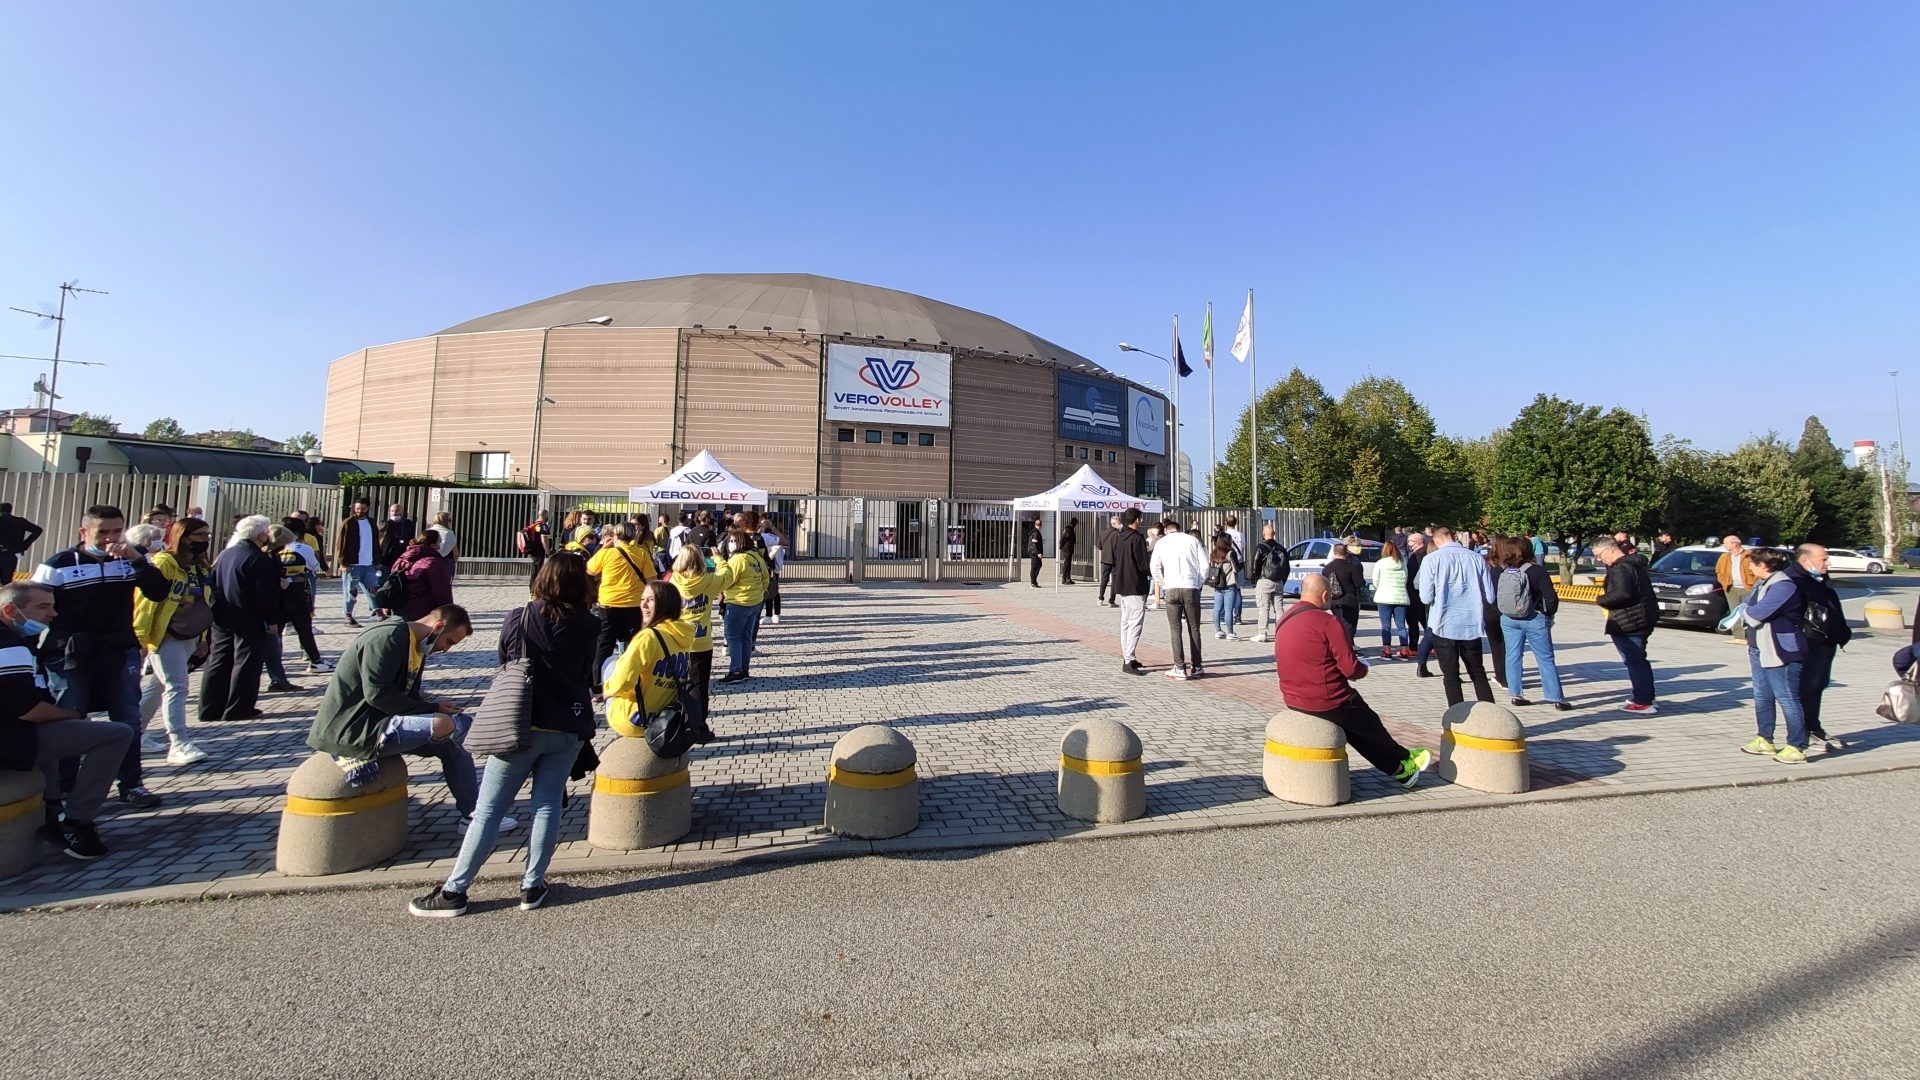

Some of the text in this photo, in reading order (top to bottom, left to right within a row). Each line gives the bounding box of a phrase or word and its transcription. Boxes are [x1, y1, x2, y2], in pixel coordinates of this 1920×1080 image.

[834, 392, 943, 409] VEROVOLLEY
[650, 491, 748, 500] VEROVOLLEY
[1073, 501, 1148, 509] VEROVOLLEY
